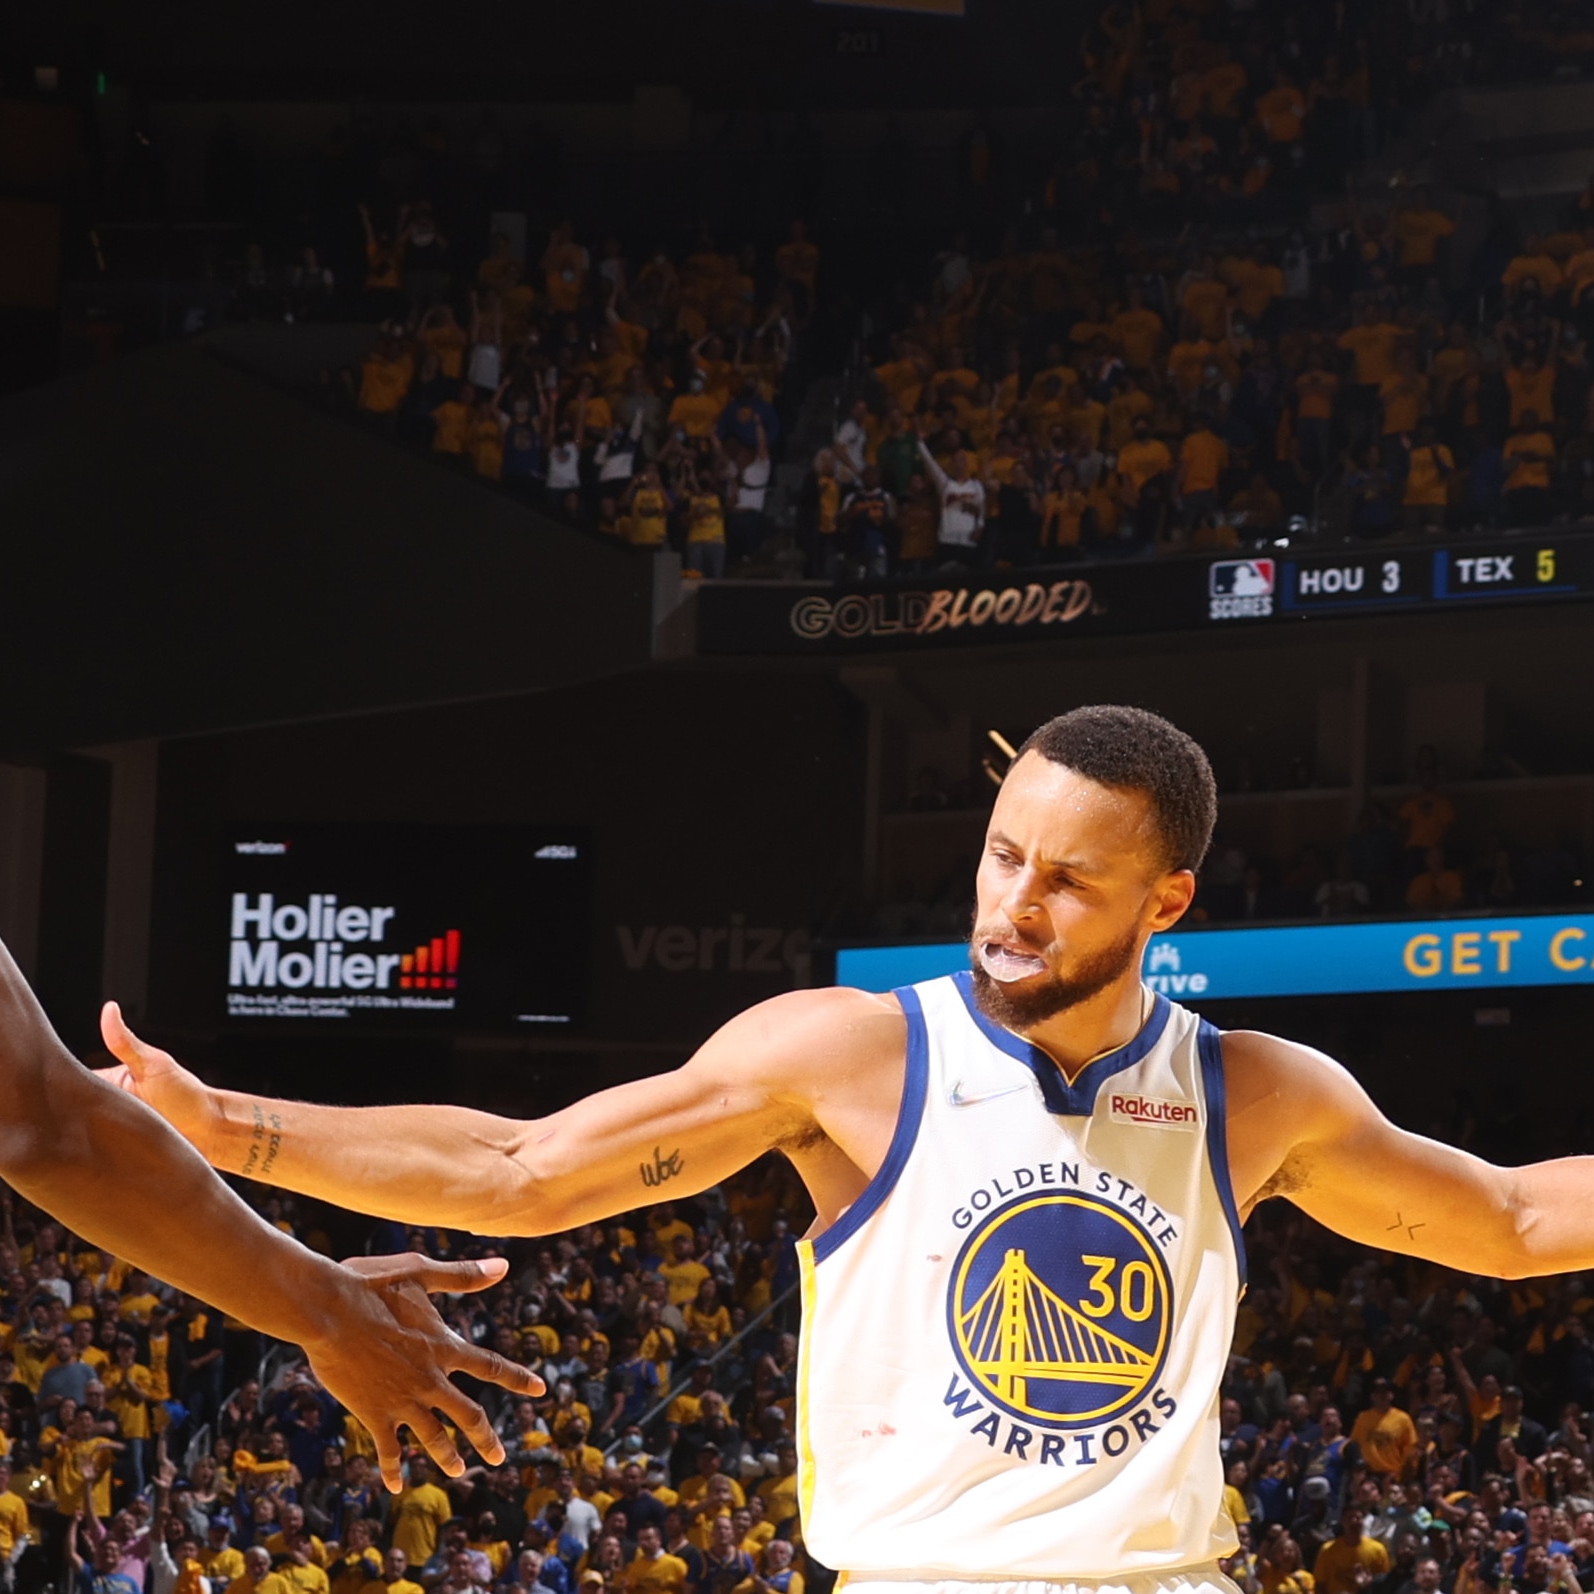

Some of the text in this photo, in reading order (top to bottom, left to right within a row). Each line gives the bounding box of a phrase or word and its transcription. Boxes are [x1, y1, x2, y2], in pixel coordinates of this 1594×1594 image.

[1300, 561, 1401, 596] HOU 3
[1456, 556, 1514, 583] TEX
[1536, 549, 1555, 582] 5
[1209, 596, 1273, 620] SCORES
[231, 892, 394, 942] Holier
[228, 939, 401, 990] Molier
[615, 912, 809, 972] verizo
[1403, 928, 1521, 977] GET
[1145, 973, 1209, 994] rive
[1111, 1095, 1198, 1125] Rakuten
[951, 1162, 1179, 1250] GOLDEN STATE
[1078, 1253, 1155, 1323] 30
[942, 1370, 1179, 1468] WARRIORS
